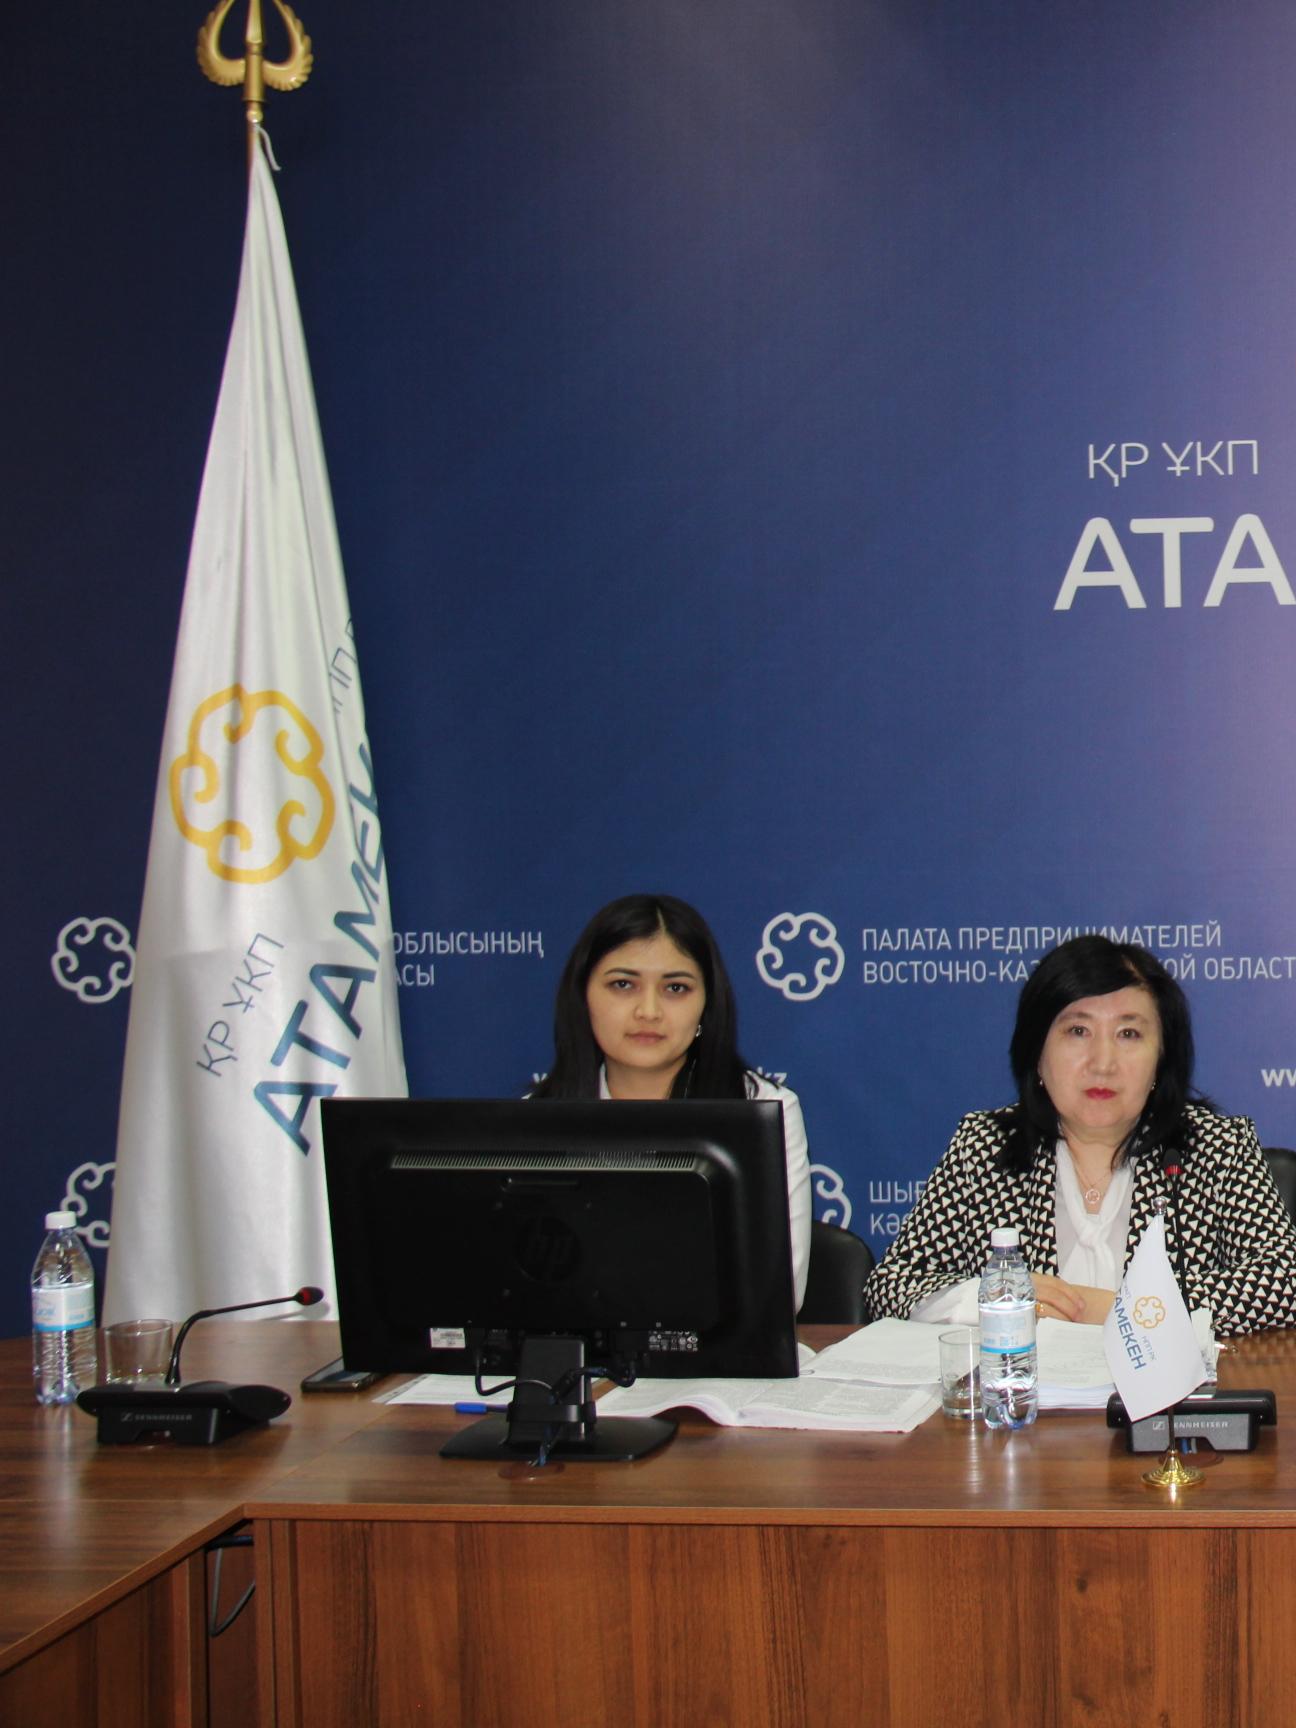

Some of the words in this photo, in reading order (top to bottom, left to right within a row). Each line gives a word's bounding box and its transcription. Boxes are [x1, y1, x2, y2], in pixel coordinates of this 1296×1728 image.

[1087, 441, 1149, 487] ҚР
[1162, 439, 1259, 478] ҰКП
[862, 928, 952, 951] ПАЛАТА
[1173, 1421, 1228, 1430] ENNHEISER
